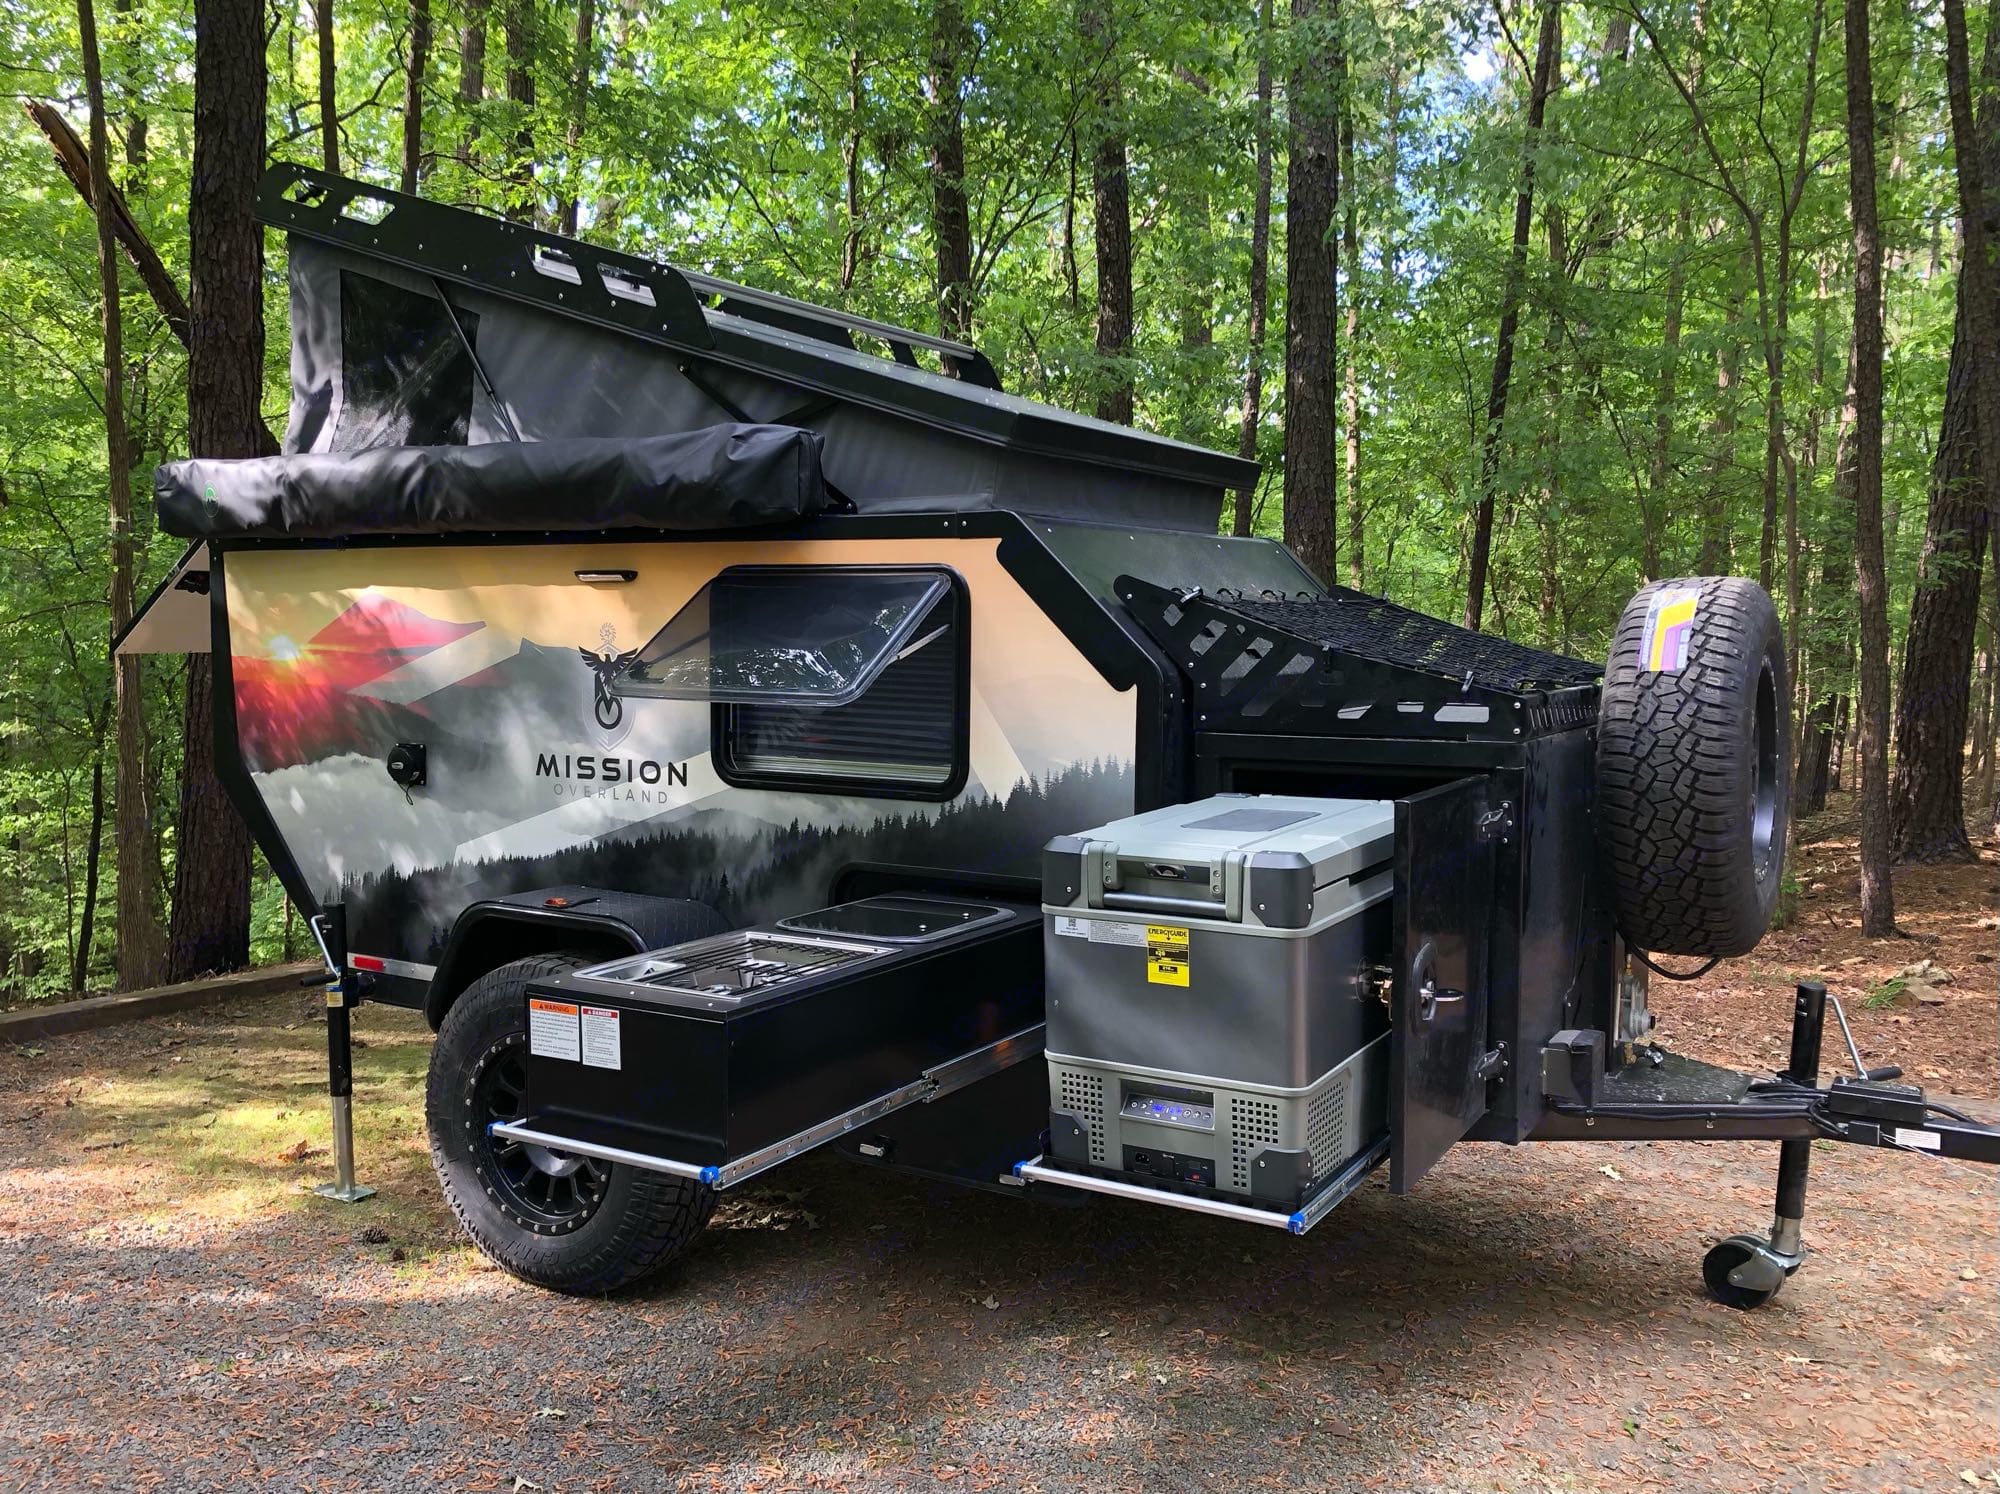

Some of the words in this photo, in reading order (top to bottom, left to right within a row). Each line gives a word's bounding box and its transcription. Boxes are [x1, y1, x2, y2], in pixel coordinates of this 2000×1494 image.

[535, 752, 688, 787] MISSION
[553, 783, 668, 804] OVERLAND
[543, 1003, 570, 1012] WARNING
